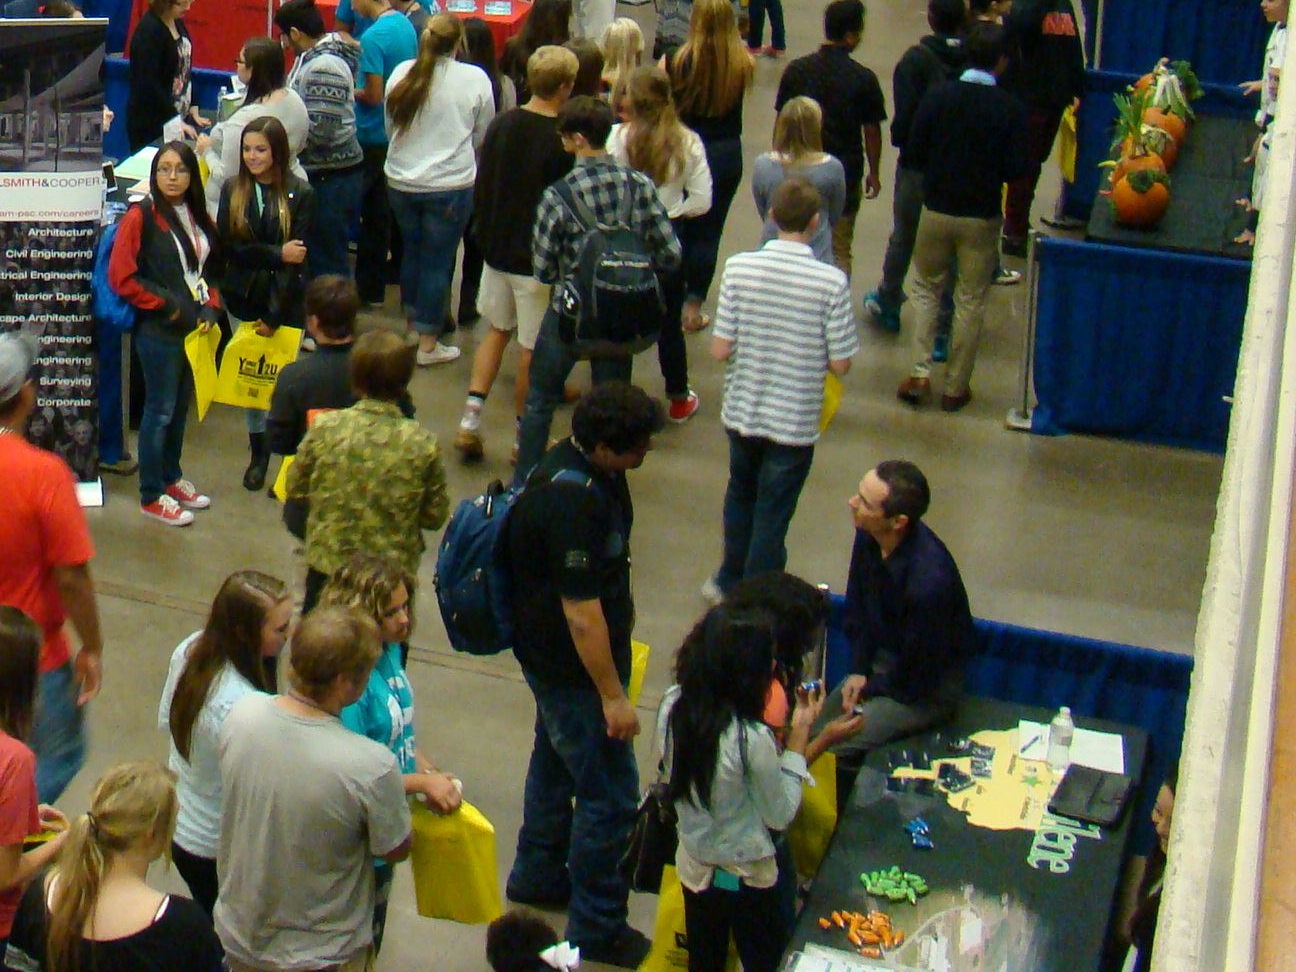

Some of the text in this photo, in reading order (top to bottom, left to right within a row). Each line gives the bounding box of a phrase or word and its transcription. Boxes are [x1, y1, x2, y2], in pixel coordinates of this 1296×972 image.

[27, 227, 93, 237] Architecture
[5, 249, 93, 260] Civil Engineering
[30, 270, 93, 281] Engineering
[15, 292, 93, 303] Interior Design
[28, 313, 92, 323] Architecture
[35, 335, 92, 346] ngineering
[33, 356, 92, 367] ngineering
[40, 376, 92, 387] Surveying
[37, 397, 91, 408] Corporate
